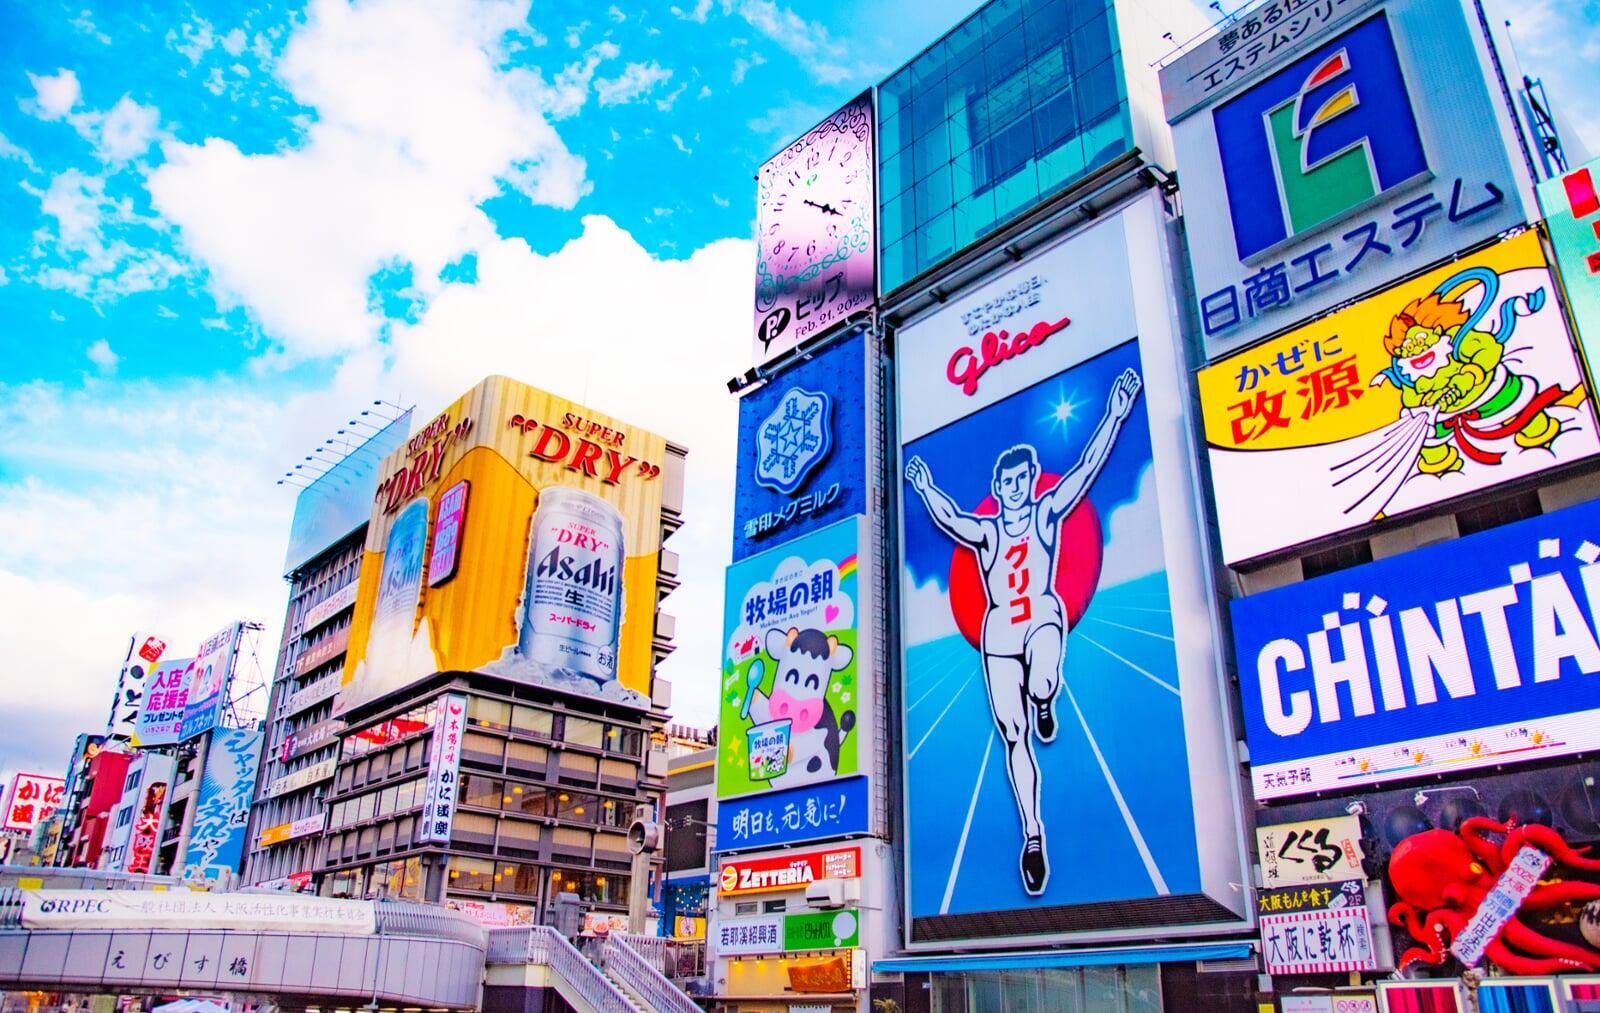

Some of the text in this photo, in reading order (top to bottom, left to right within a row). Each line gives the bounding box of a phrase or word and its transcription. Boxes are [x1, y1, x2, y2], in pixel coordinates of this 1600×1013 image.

[1201, 178, 1504, 337] 日商エステム
[795, 322, 818, 340] Feb.
[1235, 334, 1343, 393] かぜに
[1227, 354, 1365, 445] 改源
[563, 412, 626, 447] SUPER
[744, 483, 840, 538] 雪印メグミルク
[537, 545, 615, 596] Asahi
[1004, 536, 1031, 625] グリコ
[564, 588, 585, 607] 生
[745, 569, 833, 626] 牧場の朝
[1278, 828, 1343, 874] くくる
[739, 866, 815, 889] ZETTERIA
[111, 950, 248, 977] えびす橋
[1267, 919, 1355, 964] 大阪に乾杯
